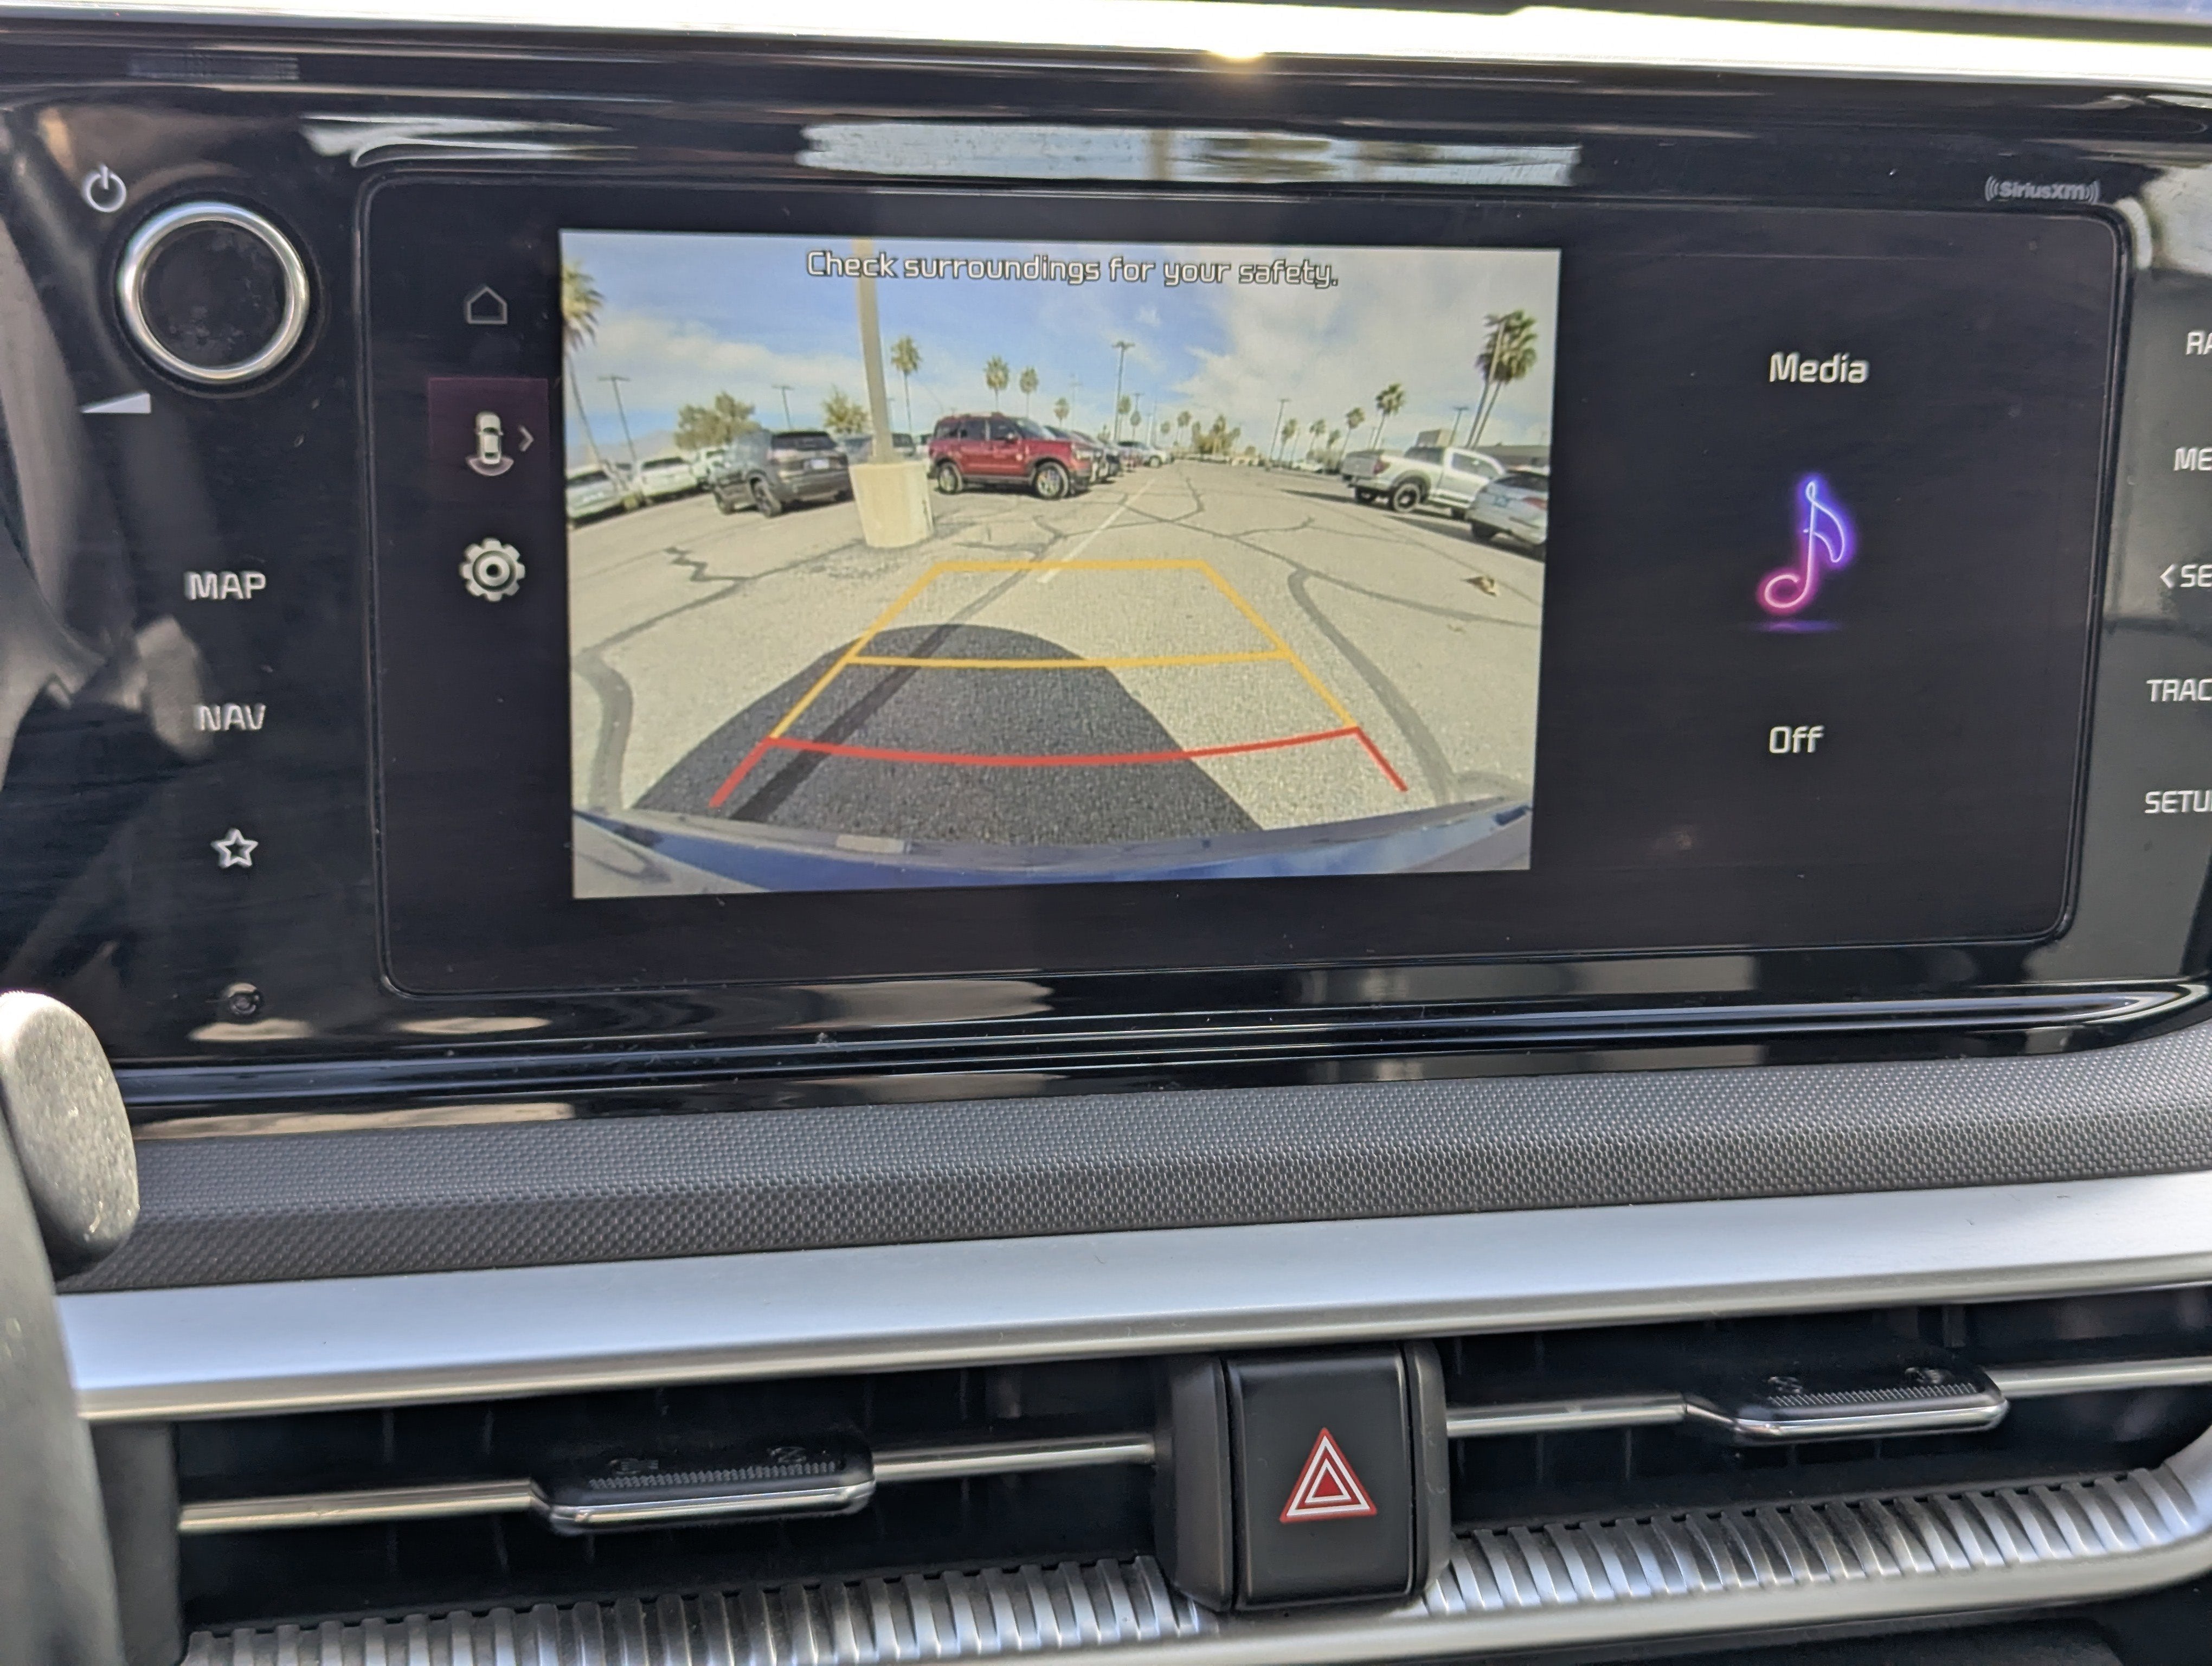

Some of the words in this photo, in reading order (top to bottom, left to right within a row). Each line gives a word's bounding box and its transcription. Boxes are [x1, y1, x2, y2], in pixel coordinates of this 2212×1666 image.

[806, 249, 898, 278] Check
[903, 253, 1101, 286] surroundings
[1109, 256, 1156, 282] for
[1163, 262, 1232, 287] your
[1238, 258, 1339, 290] safety.
[1769, 351, 1870, 383] Media
[2174, 447, 2212, 471] ME
[185, 571, 267, 600] MAP
[2145, 678, 2212, 702] TRAC
[195, 703, 266, 732] NAV
[1769, 725, 1825, 754] Off
[2145, 790, 2212, 813] SETU
